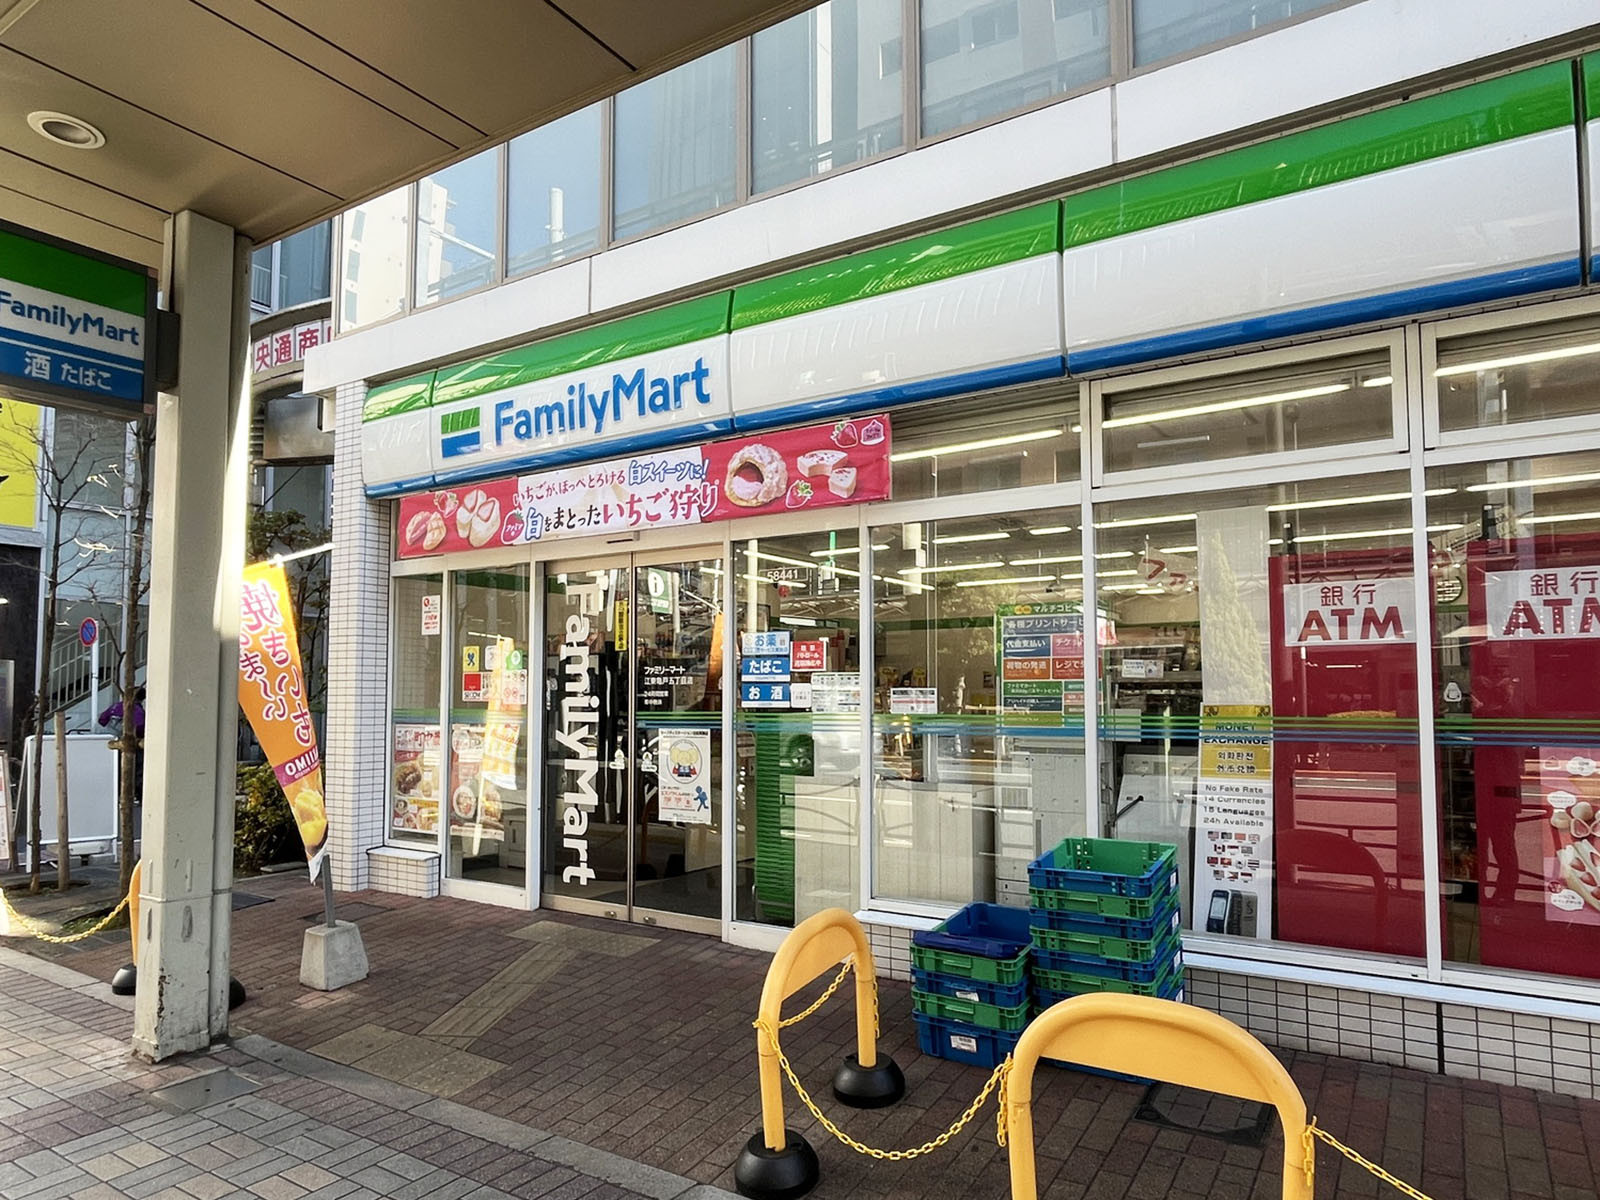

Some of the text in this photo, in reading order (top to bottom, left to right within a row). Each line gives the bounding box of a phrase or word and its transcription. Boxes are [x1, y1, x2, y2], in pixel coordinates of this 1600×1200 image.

[0, 290, 139, 346] FamilyMart
[255, 325, 331, 373] 央通商
[24, 350, 112, 391] 酒 たばこ
[495, 357, 711, 447] FamilyMart
[1530, 570, 1600, 597] 銀行
[1321, 583, 1376, 606] 銀行
[1033, 604, 1081, 613] マルチコピ
[1298, 605, 1405, 642] ATM
[1005, 639, 1046, 648] 代金支払い
[644, 665, 686, 675] ファミリーマート
[749, 660, 783, 674] たばこ
[748, 686, 783, 700] お酒
[555, 584, 600, 885] FamilyMart
[1215, 722, 1257, 732] MONEY
[1204, 735, 1269, 745] EXCHANGE
[1223, 818, 1264, 827] Available
